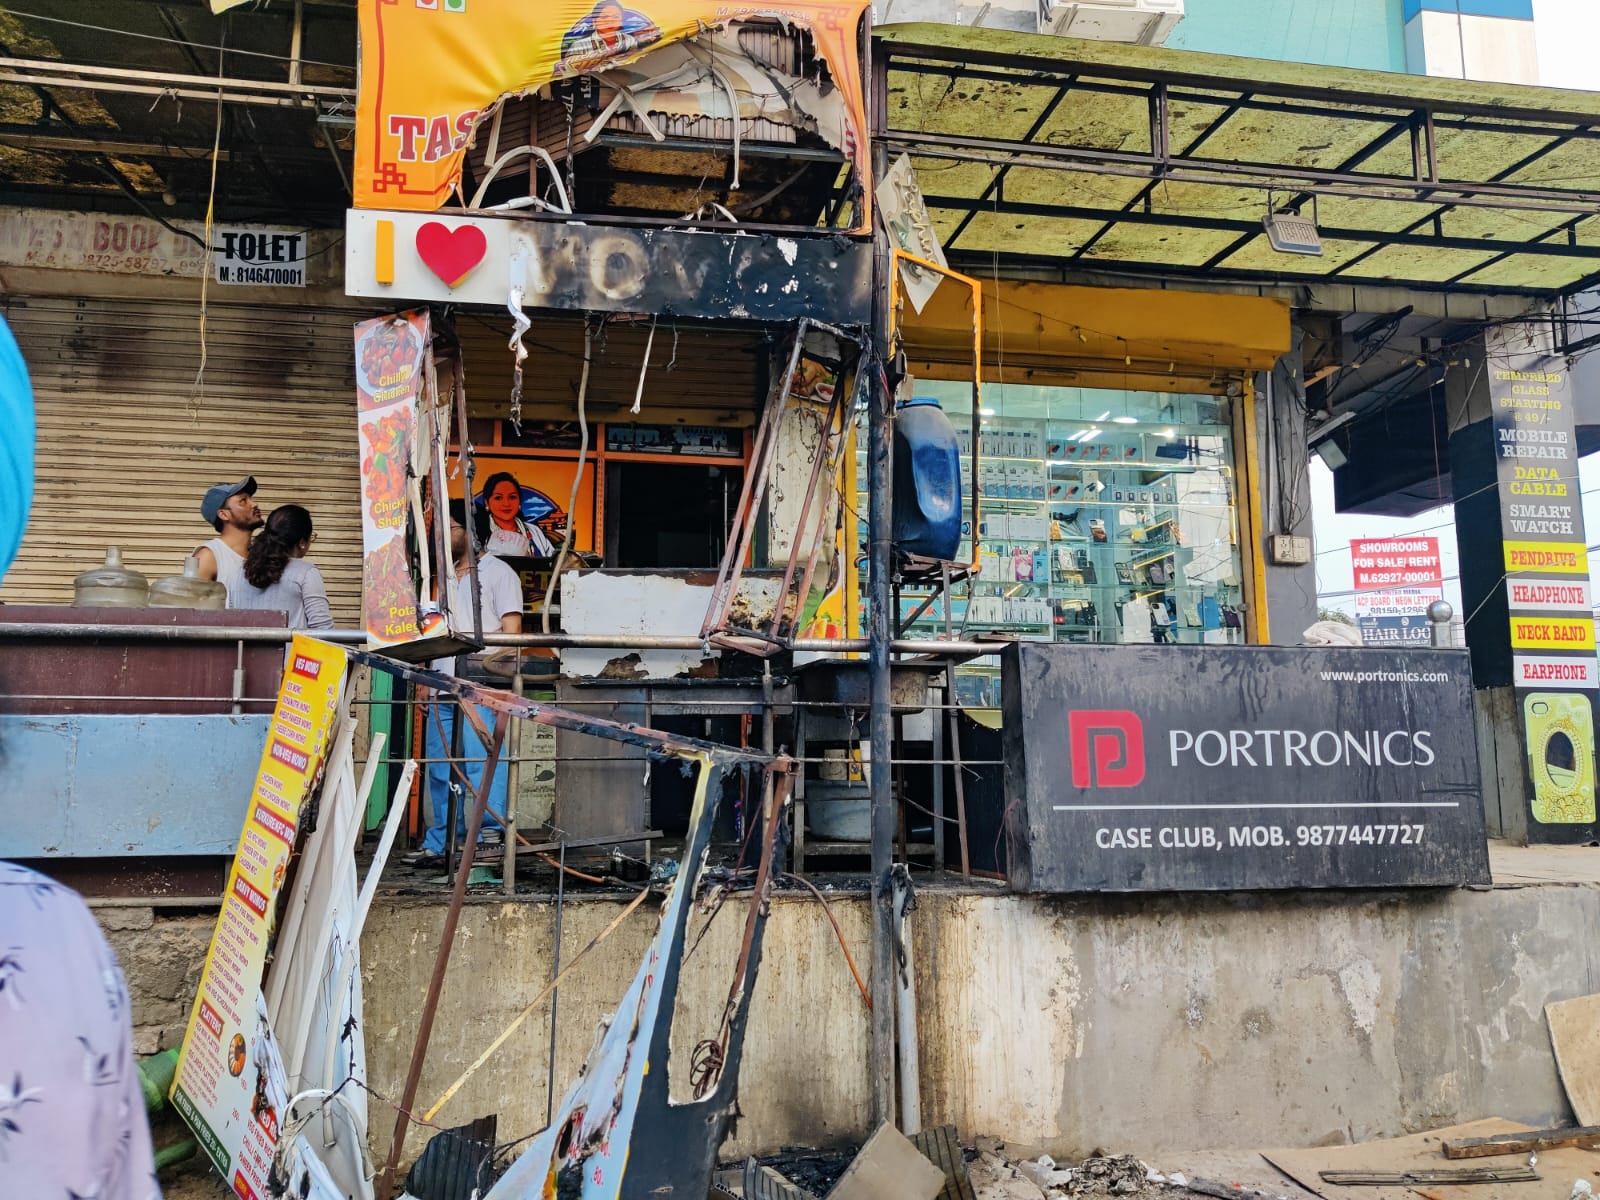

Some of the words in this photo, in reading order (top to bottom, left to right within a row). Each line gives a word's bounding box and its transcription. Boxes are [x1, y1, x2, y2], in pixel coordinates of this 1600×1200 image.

[389, 110, 488, 163] TAS
[222, 232, 302, 262] TOLET
[376, 220, 395, 286] I
[237, 267, 302, 285] 8146470001
[1495, 370, 1562, 383] TEMPERED
[1512, 385, 1550, 395] GLASS
[1500, 398, 1562, 410] STARTING
[1498, 429, 1568, 443] MOBILE
[1502, 444, 1568, 459] REPAIR
[1514, 467, 1559, 480] DATA
[1509, 482, 1568, 496] CABLE
[1509, 504, 1571, 519] SMART
[1510, 519, 1573, 534] WATCH
[1360, 542, 1429, 553] SHOWROOMS
[1353, 558, 1374, 568] FOR
[1409, 556, 1437, 567] RENT
[1510, 550, 1577, 567] PENDRIVE
[1512, 585, 1584, 605] HEADPHONE
[385, 621, 421, 636] Kaleg
[1363, 628, 1400, 641] HAIR
[1517, 624, 1550, 640] NECK
[1552, 625, 1586, 641] BAND
[1320, 669, 1449, 684] www.portronics.com
[1523, 663, 1587, 680] EARPHONE
[1168, 729, 1435, 767] PORTRONICS
[1095, 827, 1152, 849] CASE
[1158, 826, 1223, 851] CLUB,
[1229, 825, 1290, 848] MOB.
[1296, 824, 1425, 845] 9877447727
[201, 1003, 222, 1036] PLATTERS
